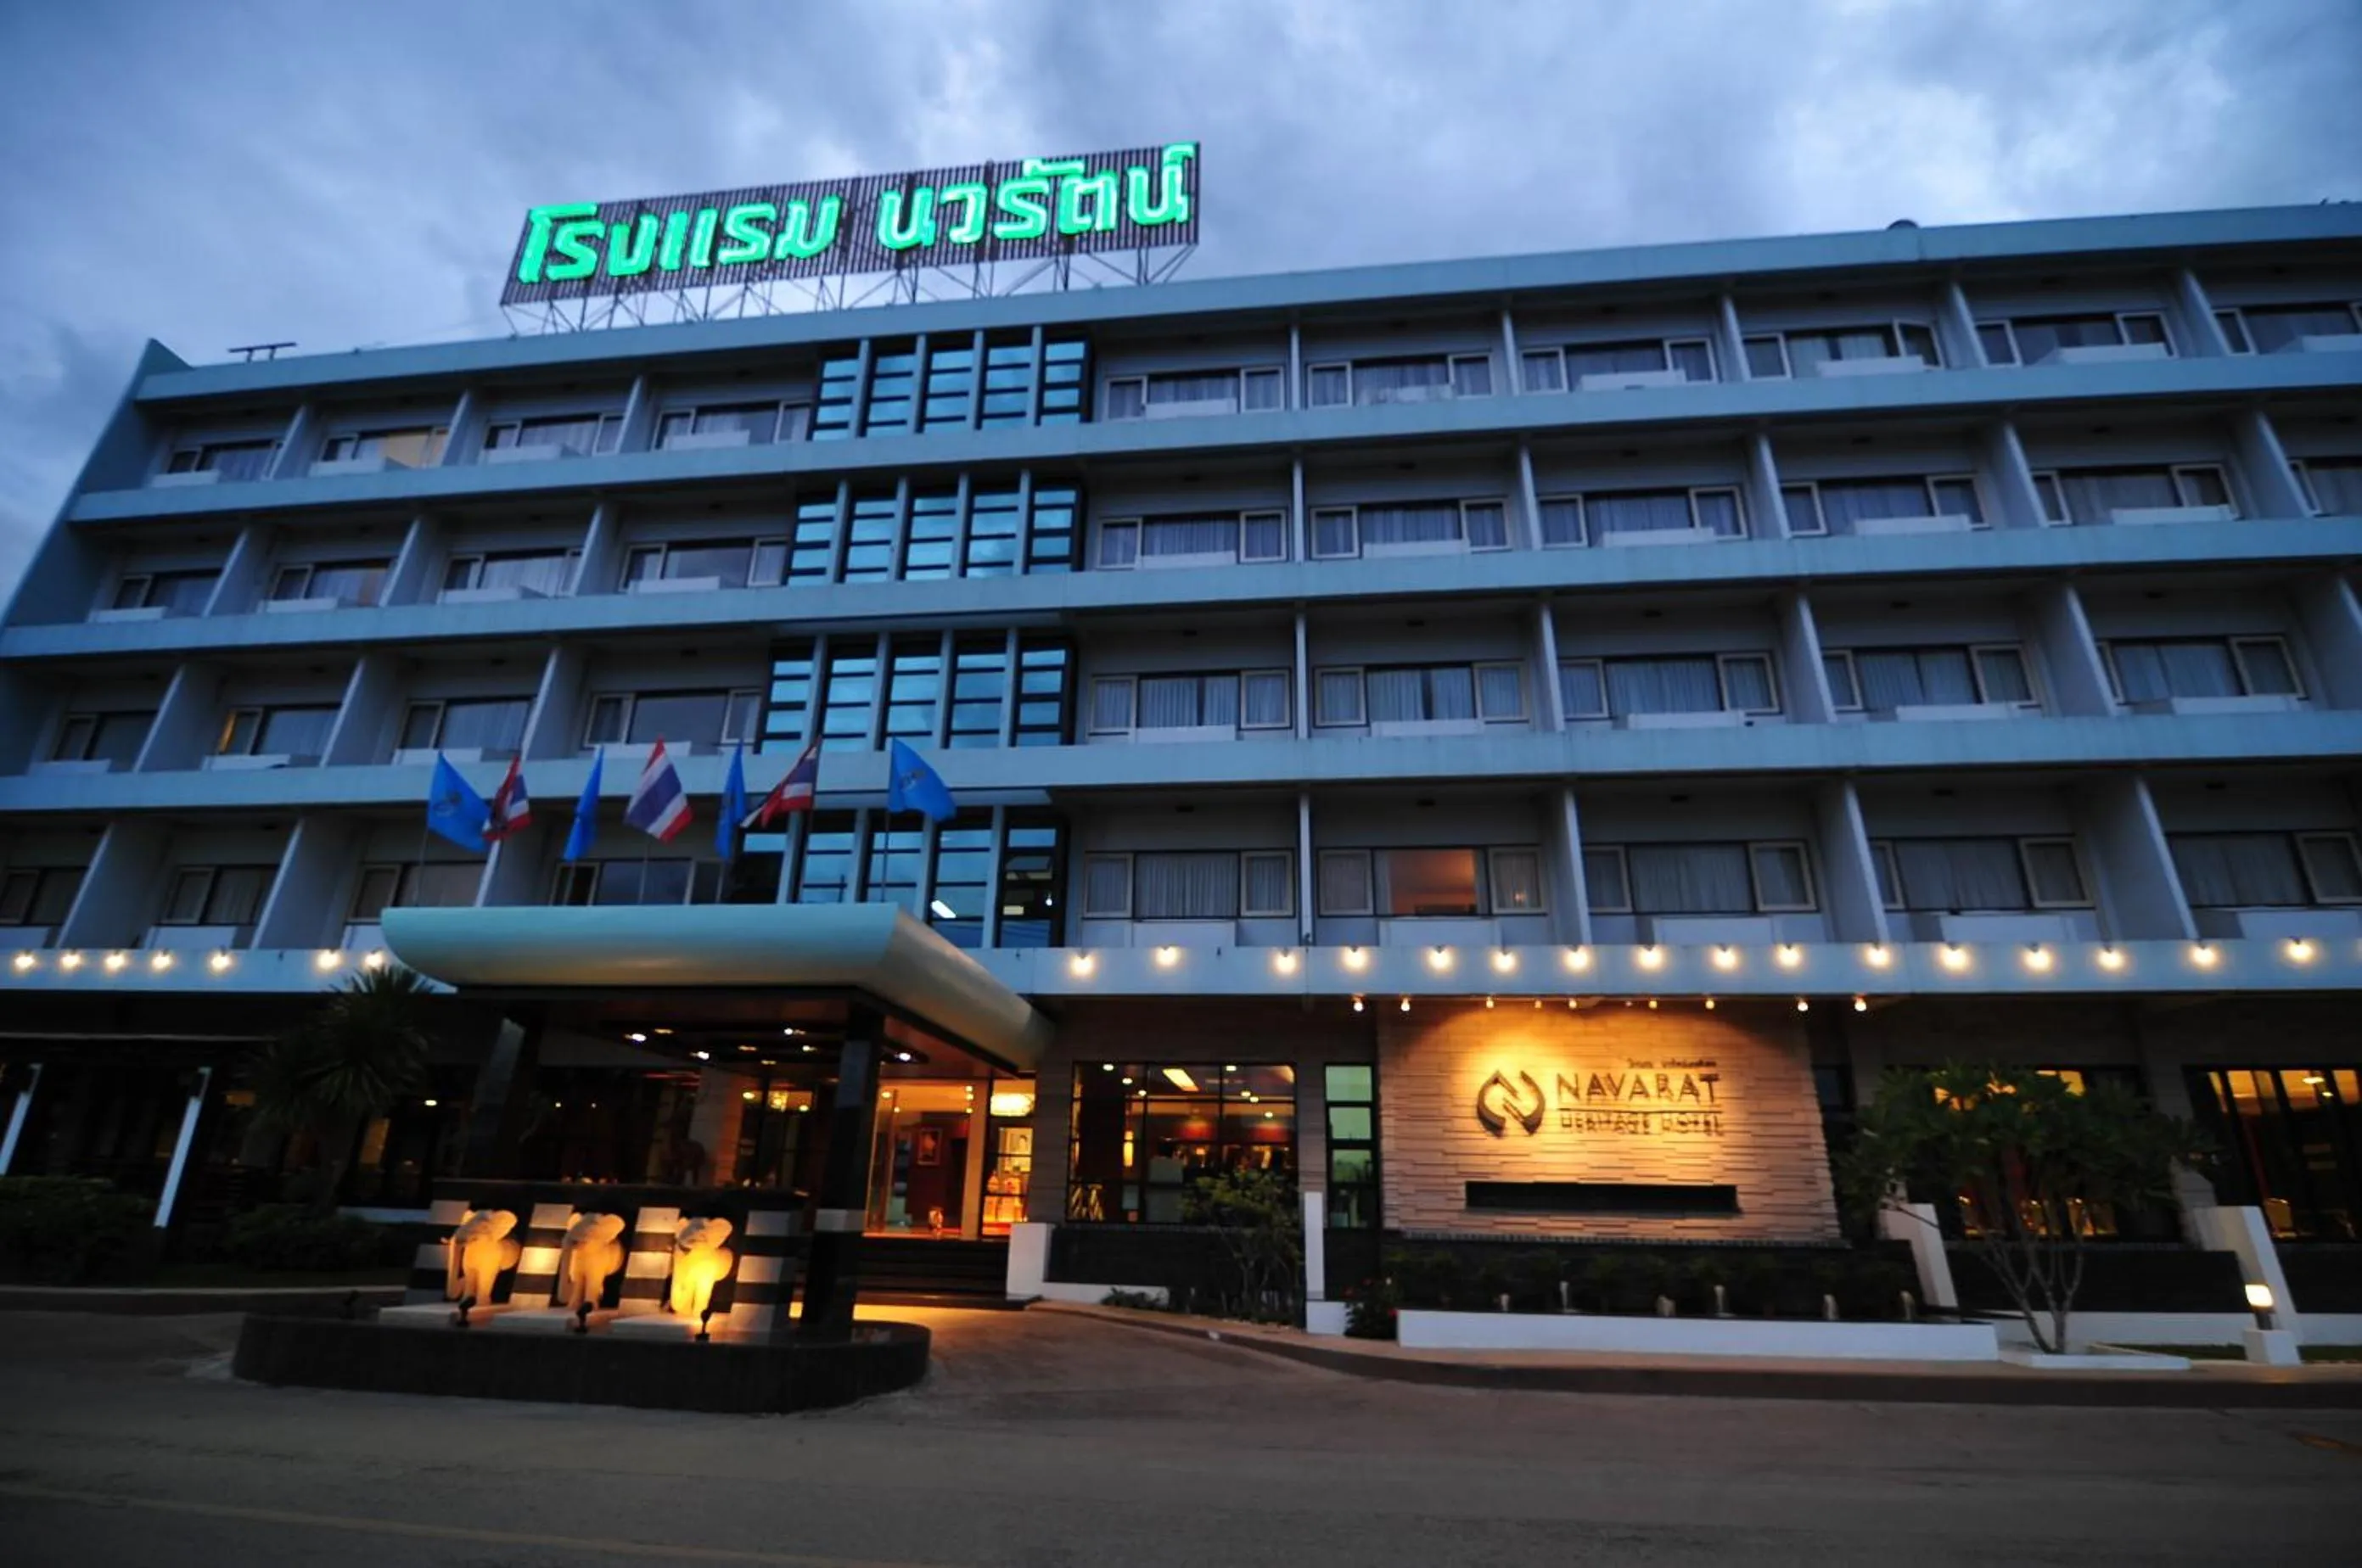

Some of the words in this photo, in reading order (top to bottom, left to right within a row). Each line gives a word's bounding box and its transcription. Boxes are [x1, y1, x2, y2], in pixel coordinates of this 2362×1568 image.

[517, 193, 841, 284] โรงแรม
[877, 142, 1195, 250] นวรัตน์
[1557, 1072, 1720, 1104] NAVARAT
